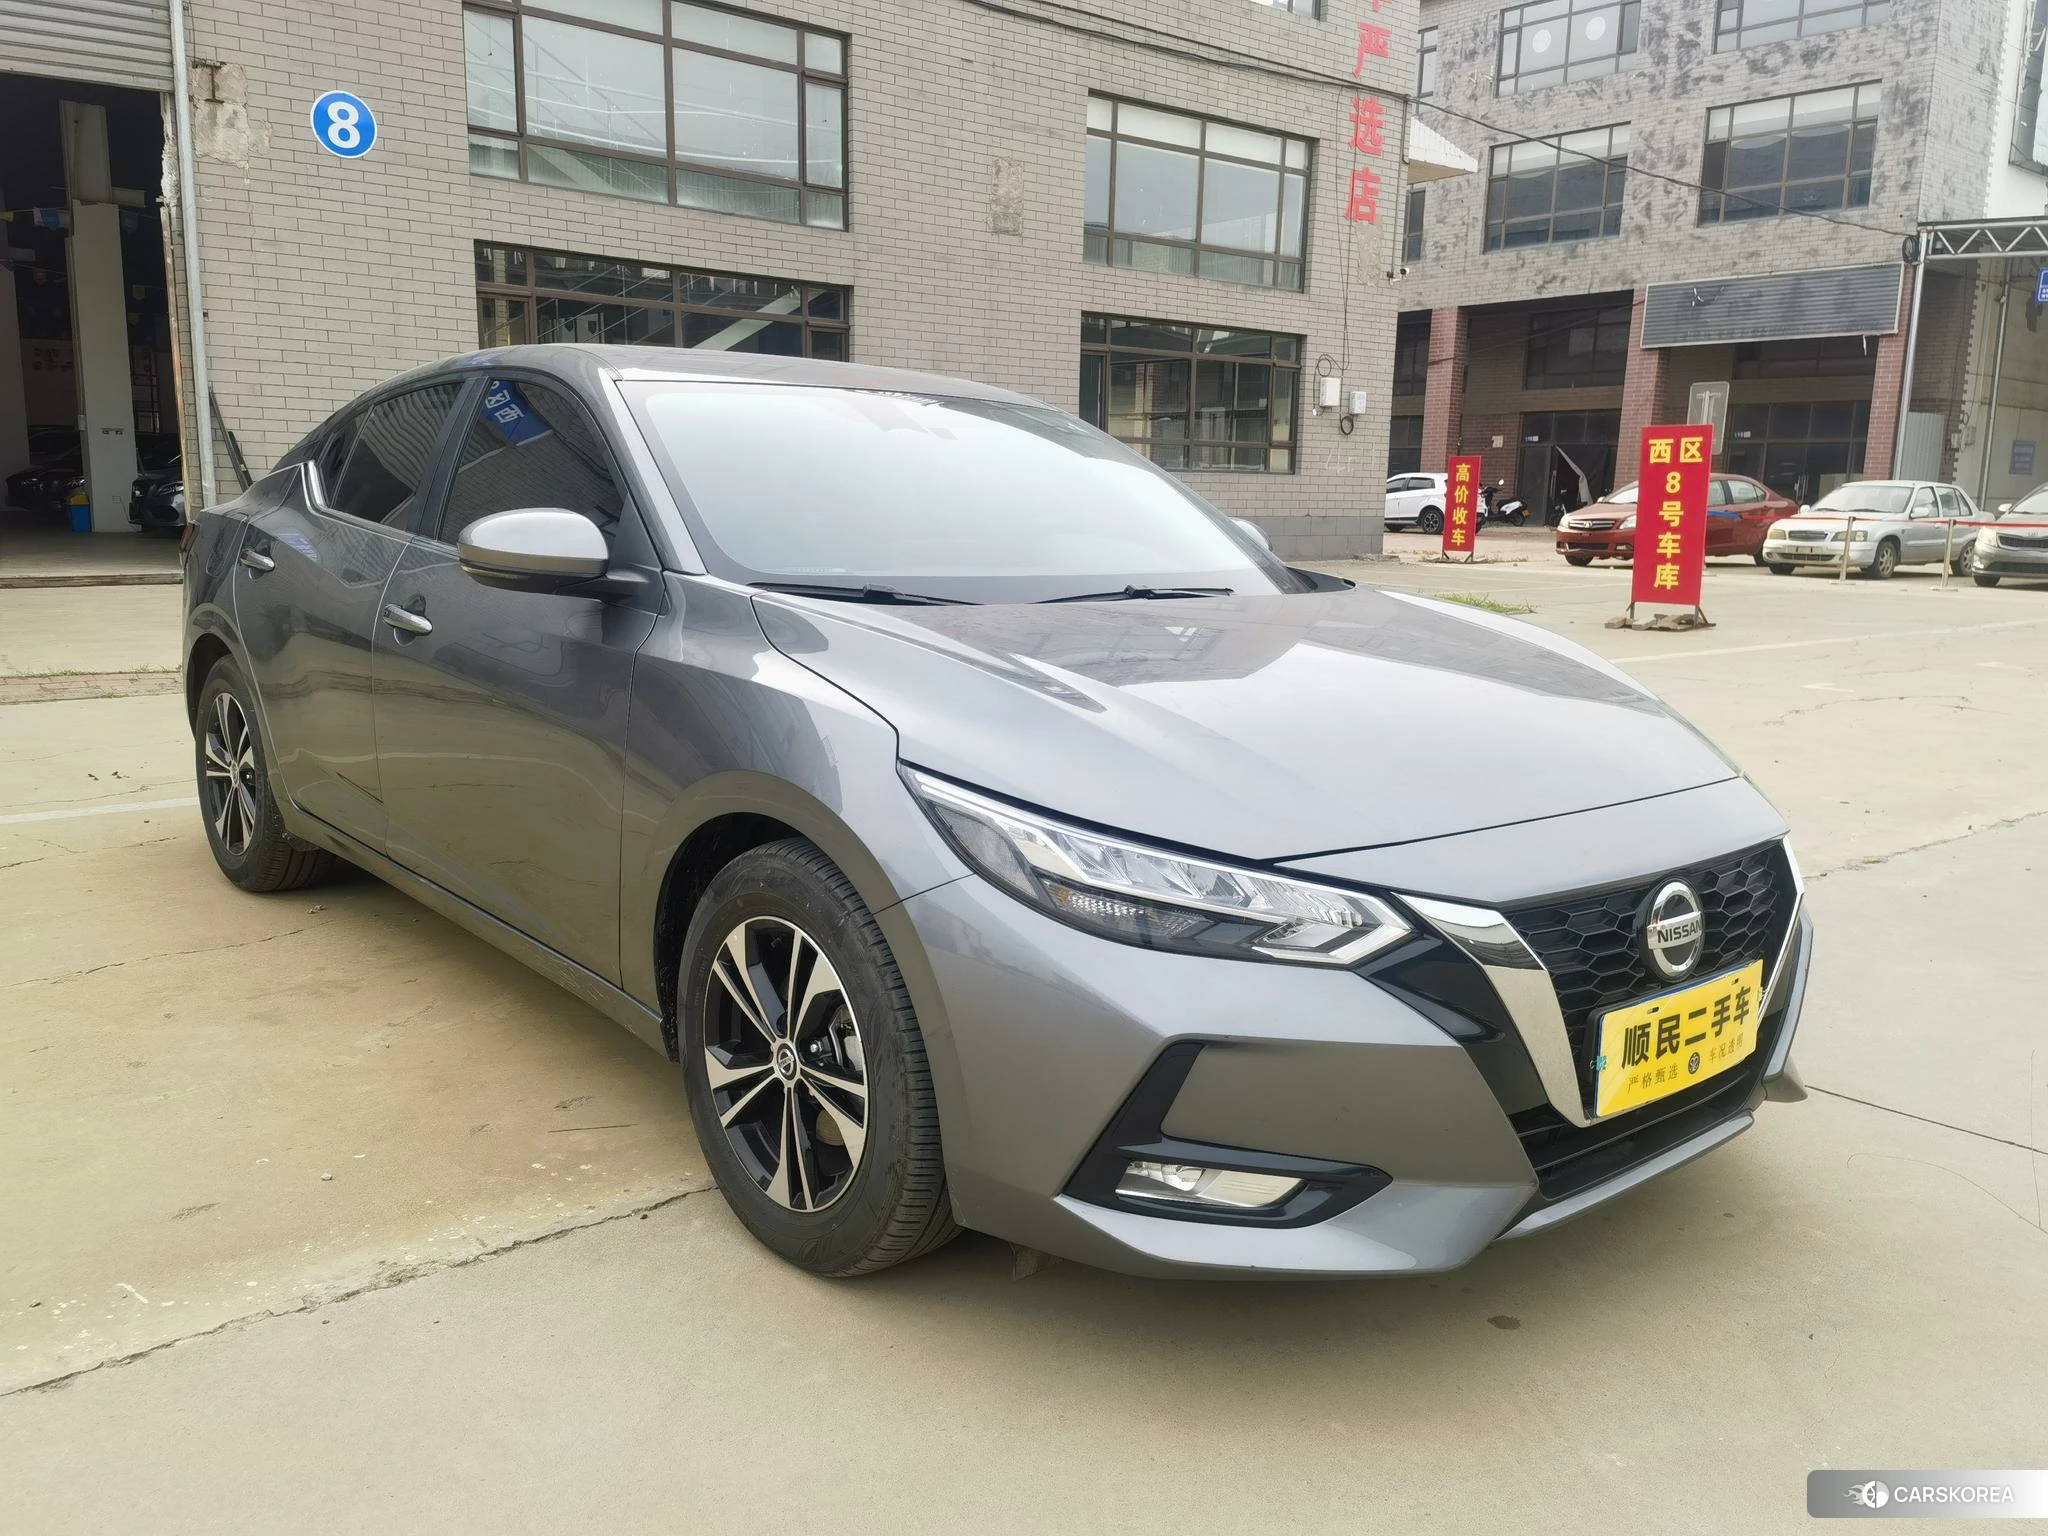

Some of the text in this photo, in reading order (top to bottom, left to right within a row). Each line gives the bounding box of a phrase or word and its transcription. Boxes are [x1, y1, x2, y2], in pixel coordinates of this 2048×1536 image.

[327, 101, 360, 149] 8
[1648, 437, 1704, 464] 西区
[1451, 463, 1471, 547] 高价收车
[1653, 471, 1684, 590] 8号车库
[1657, 919, 1701, 943] NISSAN
[1621, 985, 1751, 1069] 顺民二手车
[1627, 1063, 1679, 1094] 严格甄选
